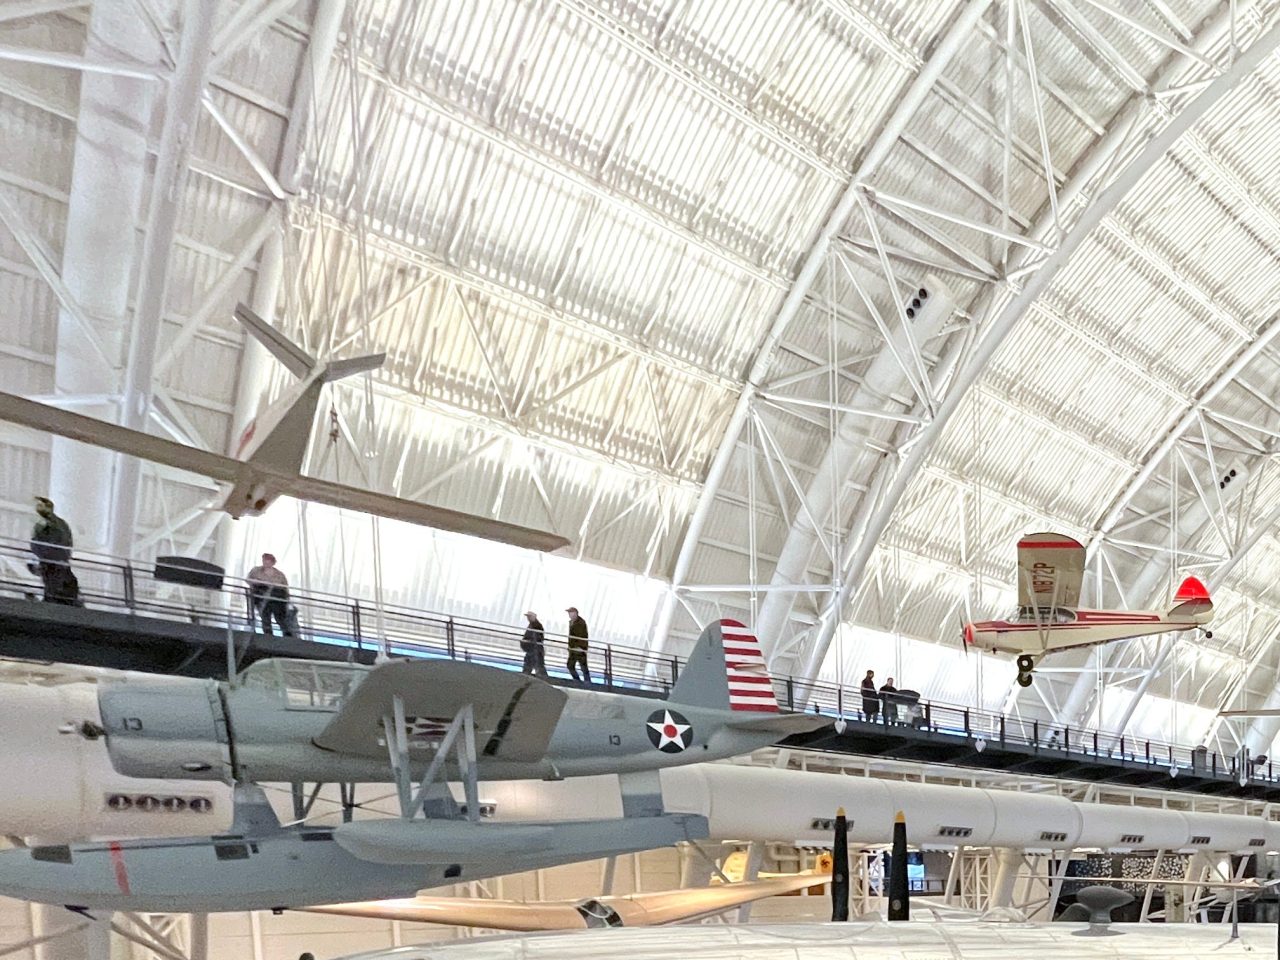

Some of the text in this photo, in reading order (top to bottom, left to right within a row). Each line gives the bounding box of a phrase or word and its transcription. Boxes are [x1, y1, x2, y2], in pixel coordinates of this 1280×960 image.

[1033, 562, 1055, 594] N872P
[122, 716, 143, 731] 13
[609, 734, 621, 746] 13
